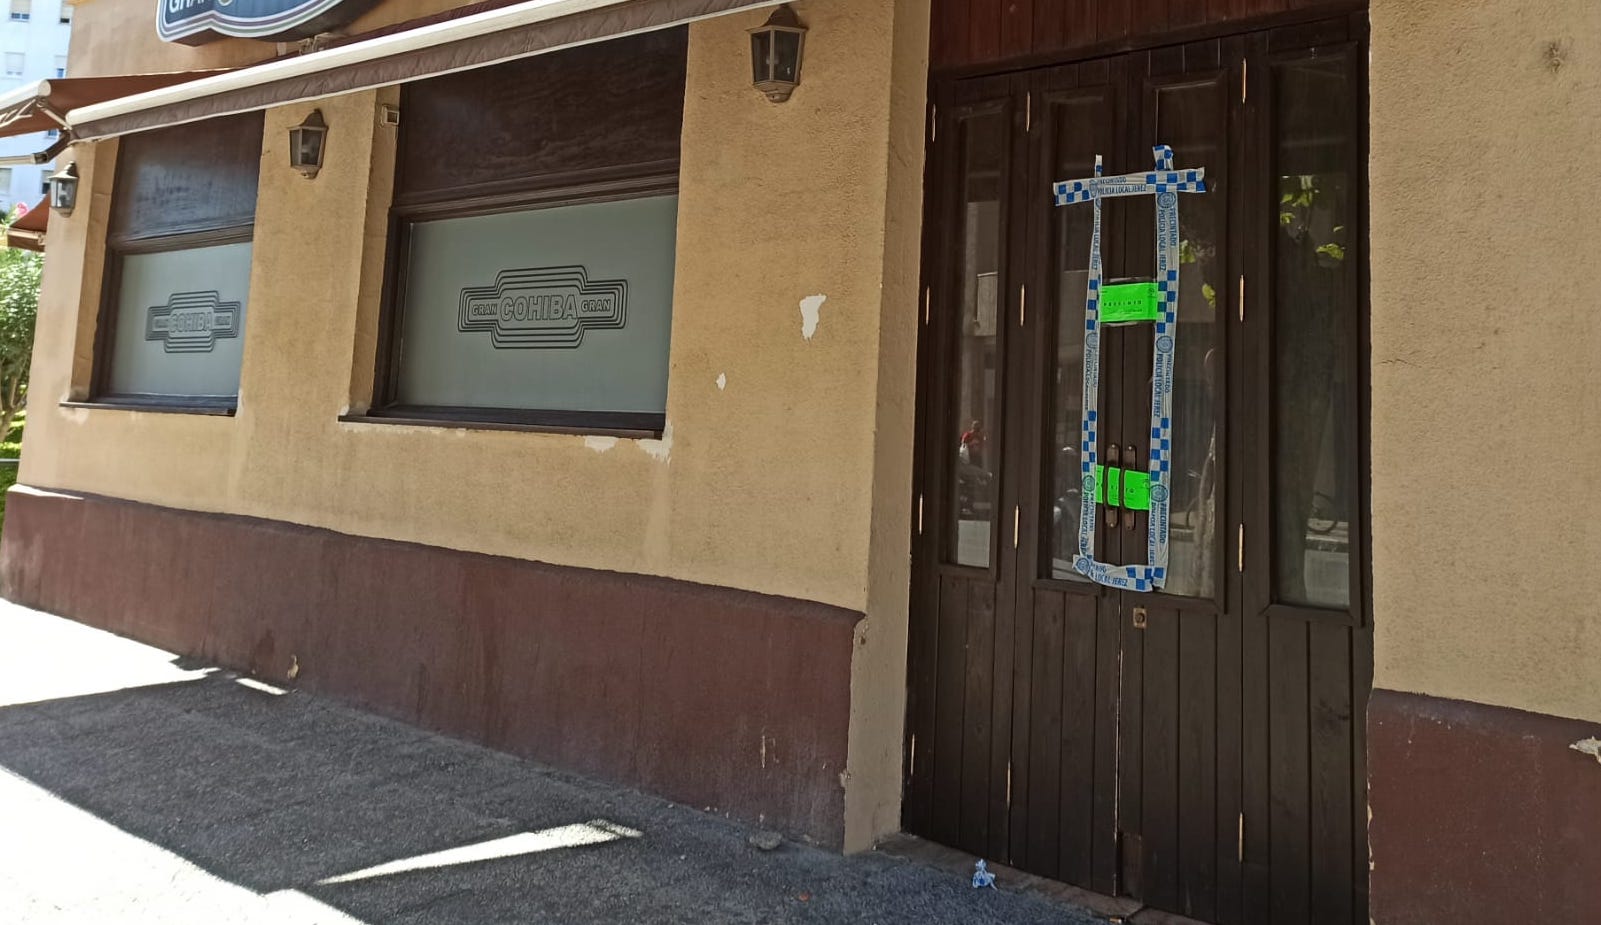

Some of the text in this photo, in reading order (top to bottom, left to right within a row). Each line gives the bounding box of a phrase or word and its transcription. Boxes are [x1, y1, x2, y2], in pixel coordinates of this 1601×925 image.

[1159, 253, 1167, 272] JEREZ
[471, 294, 612, 322] GRAN COHIBA GRAN
[169, 312, 213, 332] COHIBA
[1159, 502, 1167, 544] PRECINTADO
